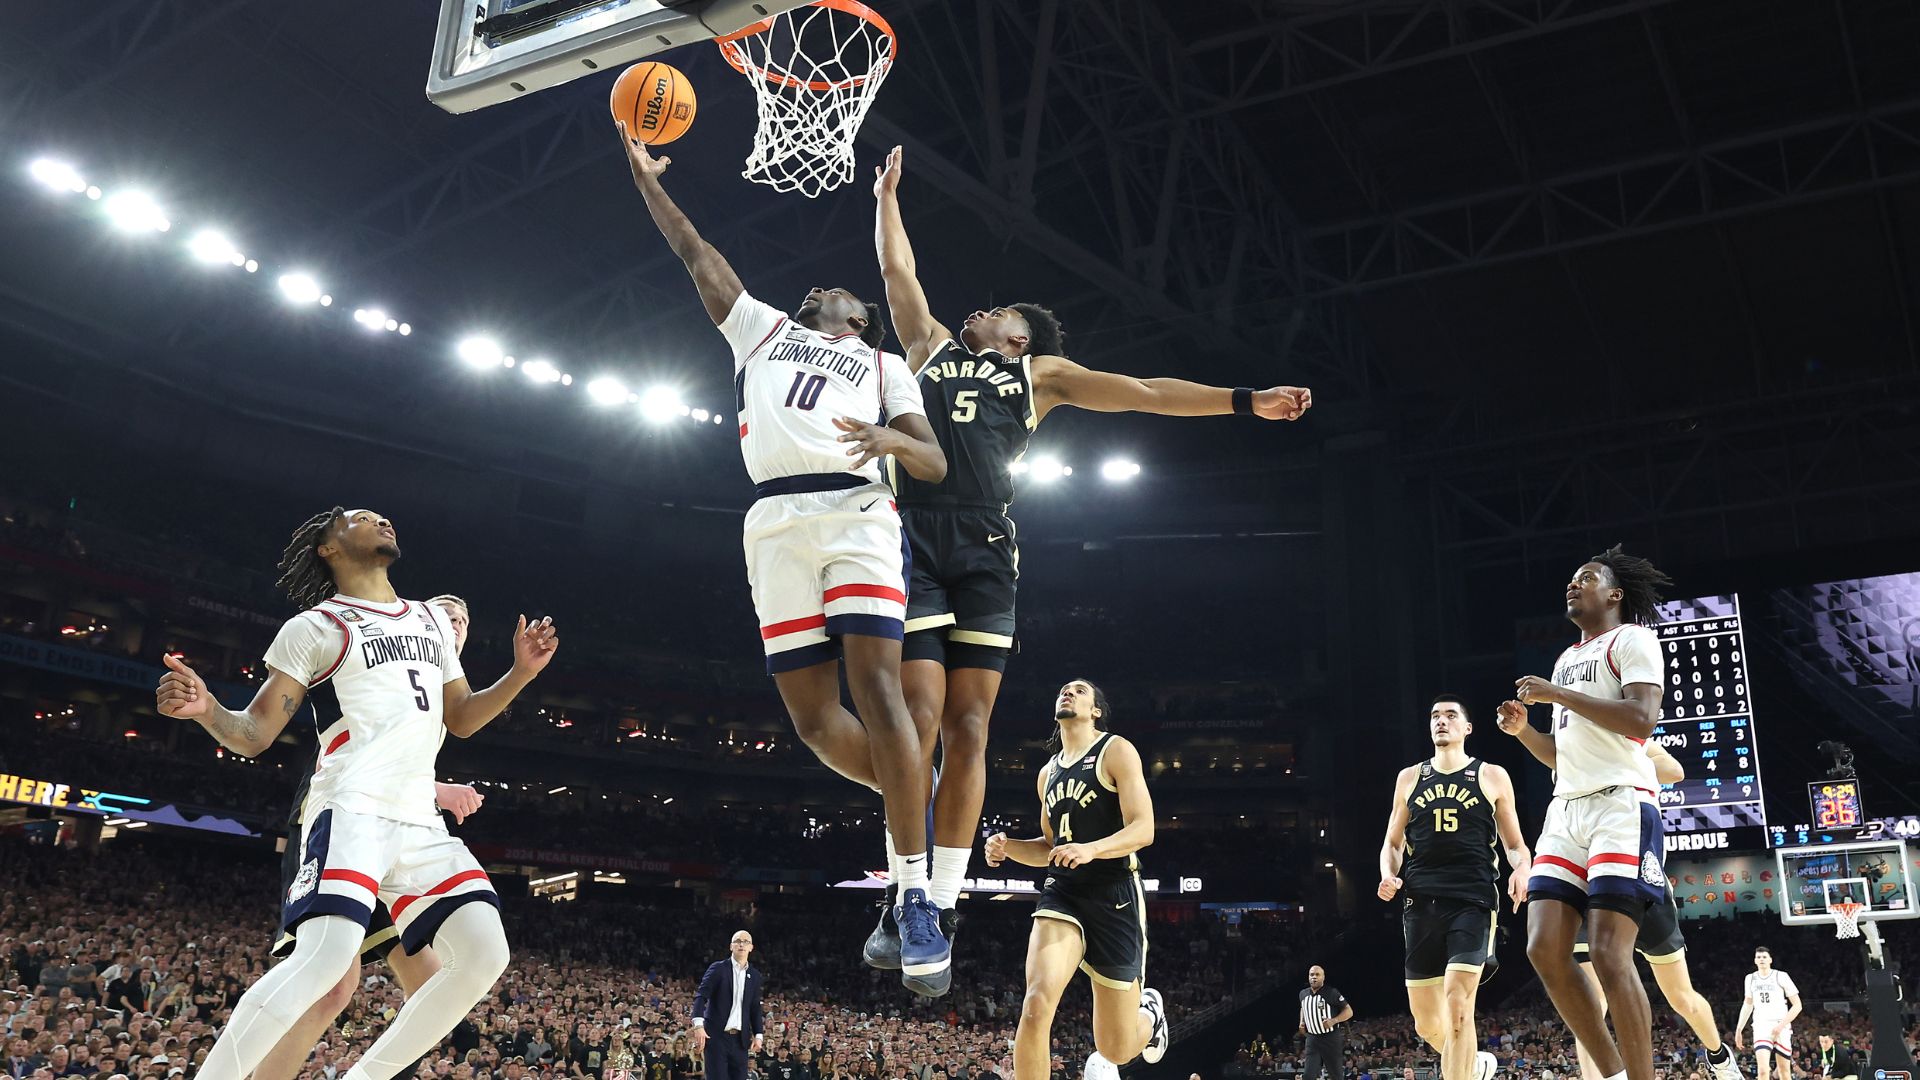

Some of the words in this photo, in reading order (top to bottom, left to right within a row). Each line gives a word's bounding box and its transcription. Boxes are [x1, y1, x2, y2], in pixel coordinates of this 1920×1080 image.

[642, 78, 667, 130] Wilson
[768, 341, 870, 387] CONNECTICUT
[925, 360, 1024, 397] PURDUE
[785, 371, 827, 411] 10
[951, 390, 979, 423] 5
[188, 596, 249, 619] CHARLEY
[249, 611, 283, 626] TRIP
[1663, 627, 1678, 635] AST
[1684, 625, 1698, 633] STL
[1703, 623, 1718, 631] BLK
[1724, 620, 1738, 628] FLS
[1668, 641, 1677, 653] 0
[1689, 640, 1696, 651] 1
[1708, 637, 1718, 648] 0
[1729, 635, 1737, 646] 1
[1670, 657, 1679, 668] 4
[1691, 656, 1698, 666] 1
[1710, 653, 1720, 664] 0
[1731, 651, 1740, 662] 0
[1672, 674, 1681, 685] 0
[1692, 671, 1701, 683] 0
[1713, 670, 1720, 681] 1
[1733, 667, 1742, 679] 2
[407, 669, 429, 711] 5
[1673, 690, 1683, 701] 0
[1694, 688, 1703, 699] 0
[1714, 686, 1724, 697] 0
[1735, 684, 1744, 695] 0
[1675, 706, 1685, 718] 0
[1696, 704, 1705, 716] 0
[1716, 702, 1726, 714] 2
[1737, 700, 1746, 712] 2
[1699, 722, 1715, 730] REB
[1731, 719, 1747, 727] BLK
[1700, 731, 1717, 744] 22
[1735, 729, 1744, 740] 3
[1702, 749, 1719, 758] AST
[1735, 747, 1749, 755] TO
[1707, 760, 1717, 771] 4
[1739, 757, 1748, 769] 8
[1706, 778, 1722, 786] STL
[1736, 775, 1755, 784] POT
[0, 774, 70, 807] HERE
[1046, 778, 1098, 808] URDUE
[1414, 783, 1479, 810] PURDUE
[1710, 788, 1720, 800] 2
[1742, 785, 1751, 797] 9
[1822, 784, 1855, 799] 9:29
[1433, 808, 1459, 832] 15
[1821, 799, 1855, 825] 26
[1059, 812, 1073, 842] 4
[1770, 825, 1787, 833] TOL
[1894, 819, 1920, 836] 40
[1664, 832, 1729, 852] URDUE
[1775, 833, 1784, 845] 3
[1799, 832, 1808, 843] 5
[504, 848, 534, 859] 2024
[537, 851, 568, 863] NCAA
[608, 857, 639, 870] FINAL
[641, 860, 671, 872] FOUR
[1759, 992, 1770, 1003] 32
